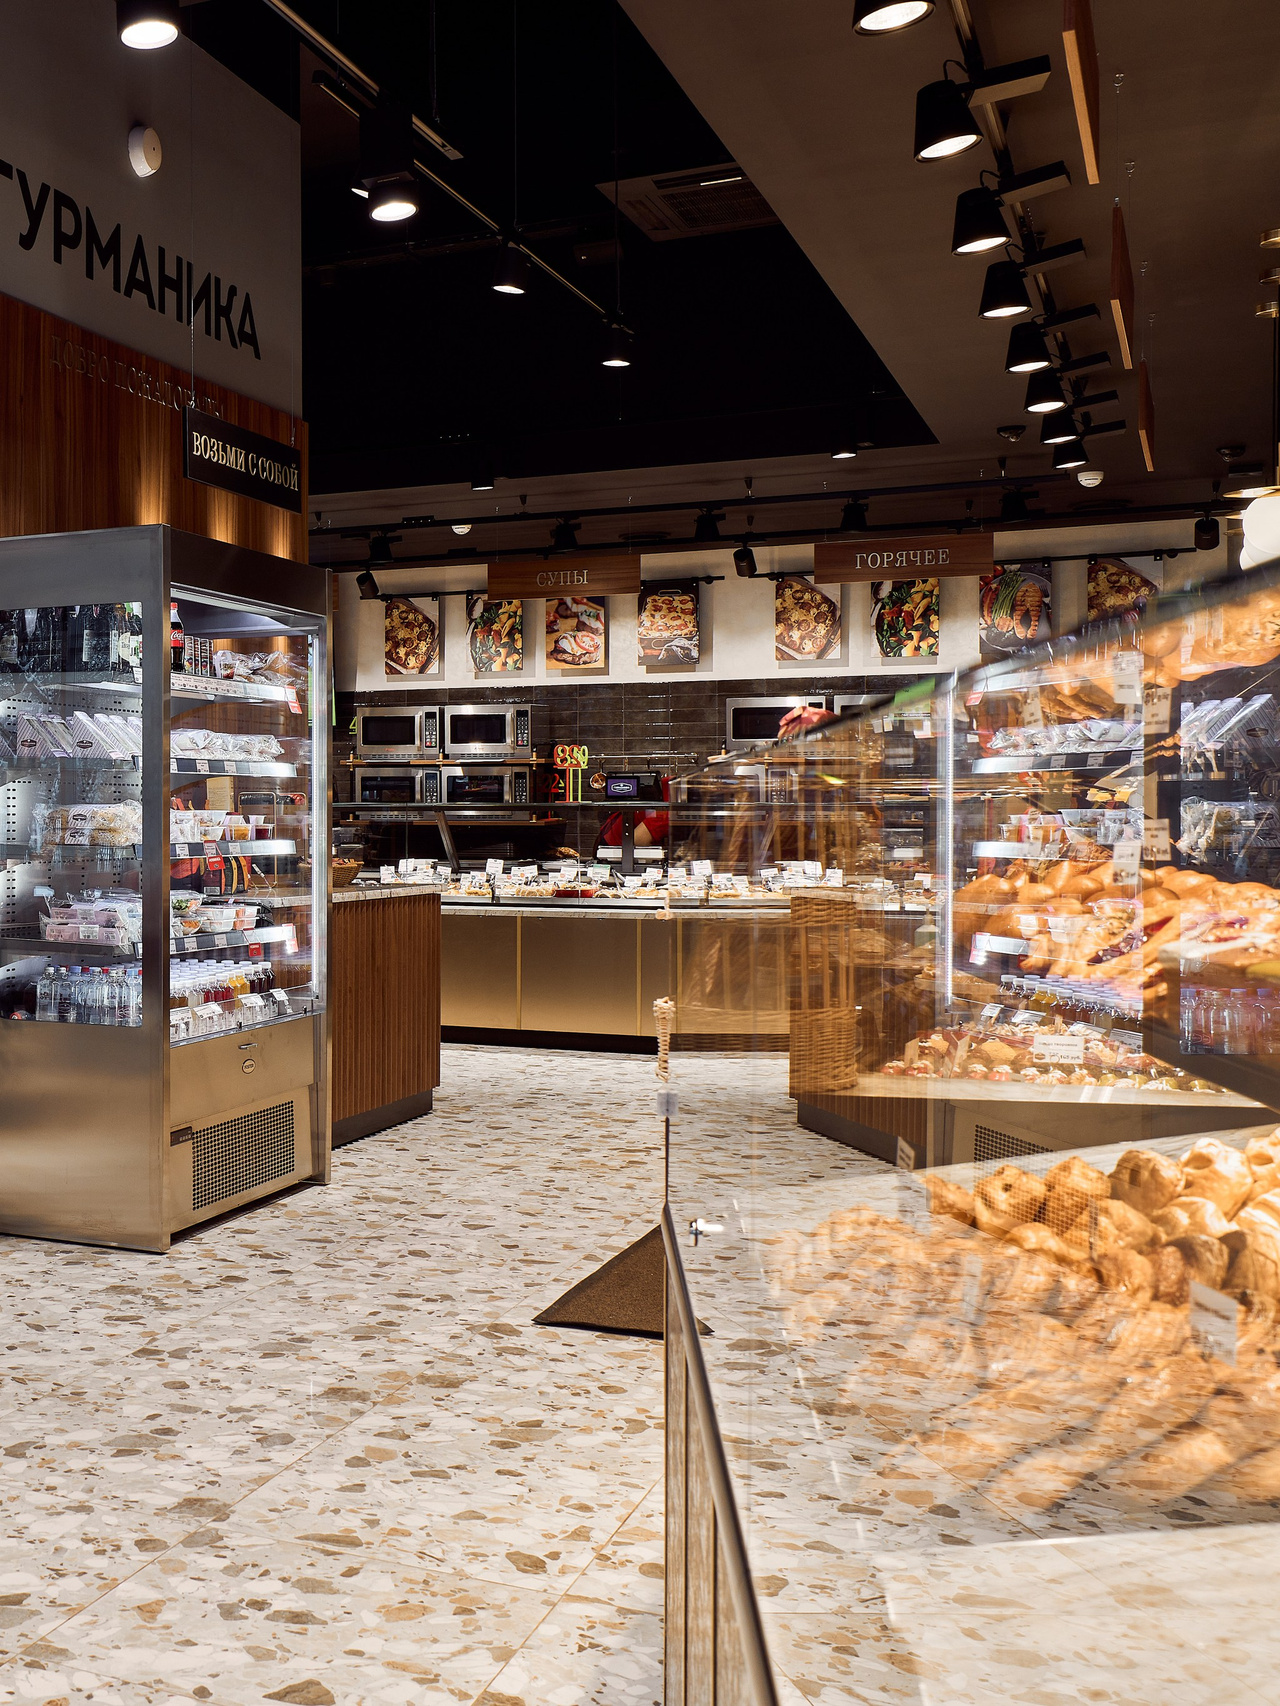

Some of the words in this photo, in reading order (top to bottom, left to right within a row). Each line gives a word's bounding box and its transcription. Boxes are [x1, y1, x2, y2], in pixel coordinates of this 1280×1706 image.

[50, 335, 109, 383] ДОБРО
[192, 431, 246, 473] ВОЗЬМИ
[248, 453, 257, 476] С
[258, 456, 299, 492] СОБОЙ
[855, 549, 950, 569] ГОРЯЧЕЕ
[536, 570, 589, 586] СУПЫ
